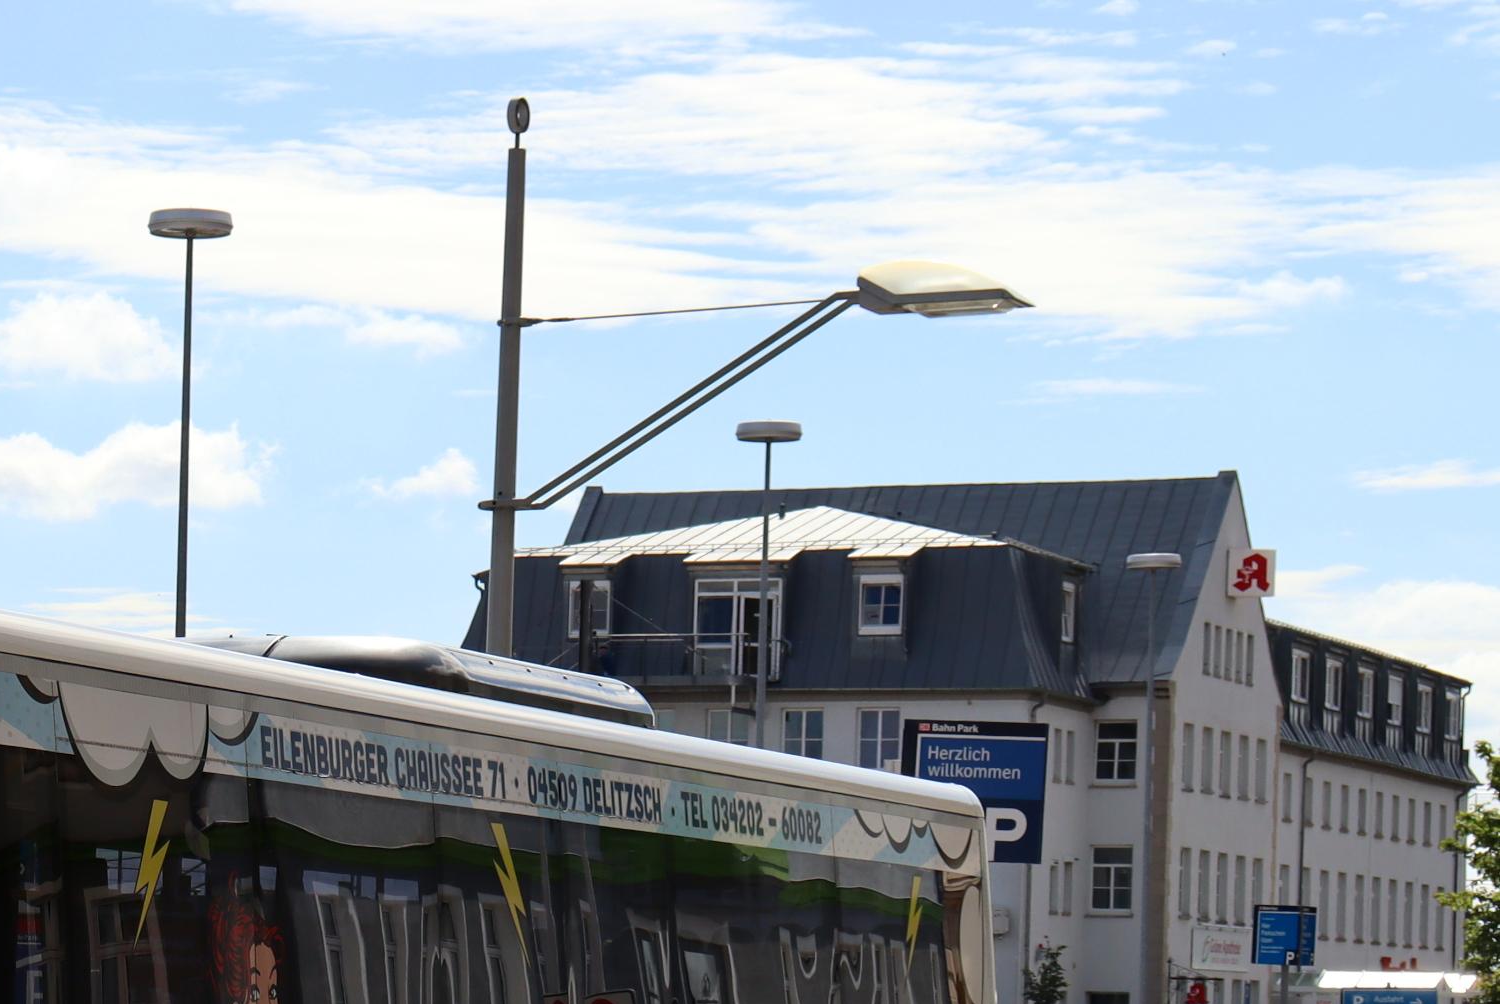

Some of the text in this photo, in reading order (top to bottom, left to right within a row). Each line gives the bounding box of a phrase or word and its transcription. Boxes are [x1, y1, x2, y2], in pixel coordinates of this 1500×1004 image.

[932, 723, 956, 732] Bahn
[957, 724, 979, 733] Park
[928, 745, 990, 762] Herzlich
[928, 763, 1021, 780] willkommen
[260, 725, 390, 785] EILENBURGER
[395, 747, 484, 798] CHAUSSEE
[487, 760, 506, 799] 71
[527, 765, 578, 811] 04509
[582, 776, 662, 823] DELITZSCH
[680, 791, 708, 829] TEL
[711, 795, 764, 836] 034202
[781, 807, 822, 844] 60082
[985, 807, 1027, 861] P
[1285, 952, 1295, 965] P
